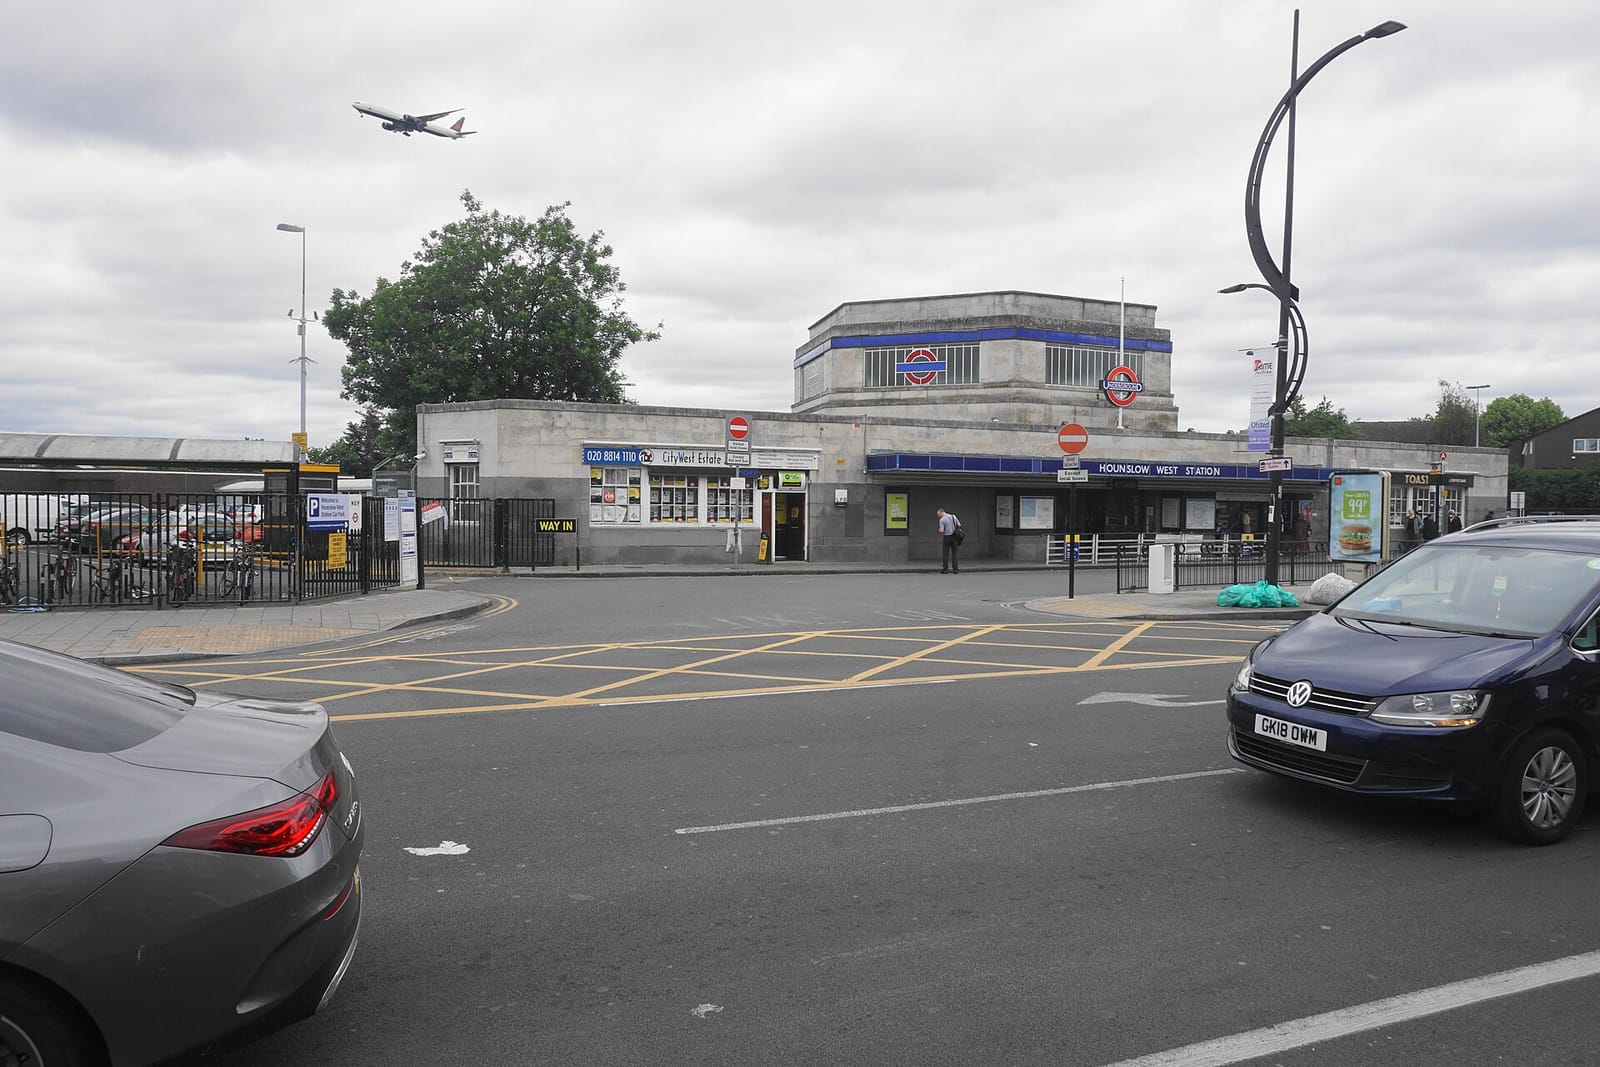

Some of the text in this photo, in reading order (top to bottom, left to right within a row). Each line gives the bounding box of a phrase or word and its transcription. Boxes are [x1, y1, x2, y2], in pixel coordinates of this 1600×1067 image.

[587, 450, 636, 461] 020 8814 1110
[663, 451, 721, 465] CityWest Estate
[1100, 464, 1220, 476] HOUNSLOW WEST STATION
[540, 521, 573, 531] WAY IN
[1262, 718, 1317, 746] GK18 OWM
